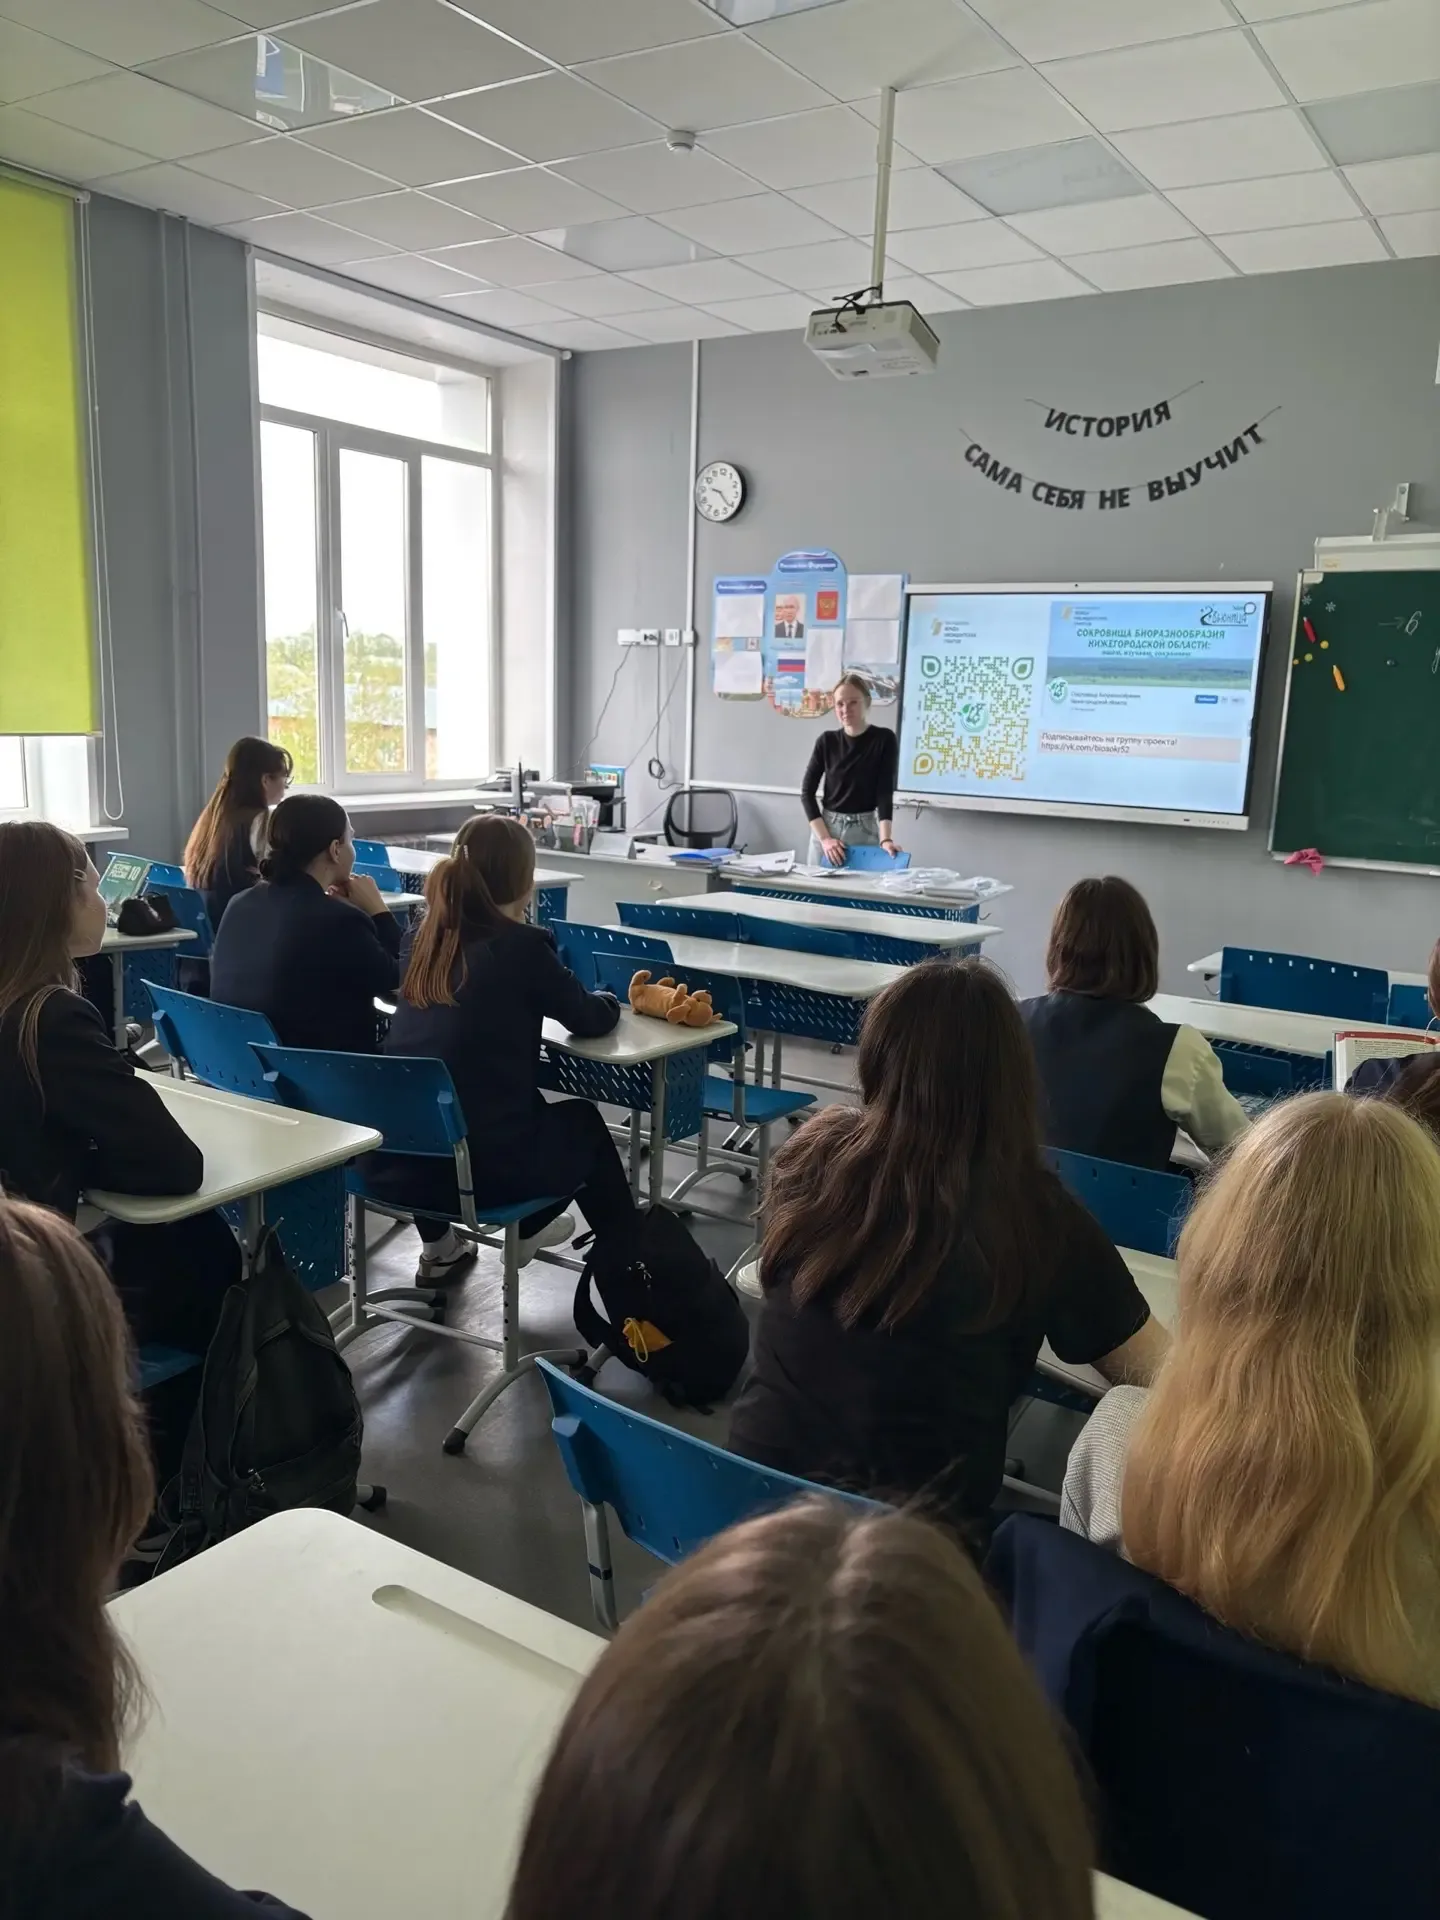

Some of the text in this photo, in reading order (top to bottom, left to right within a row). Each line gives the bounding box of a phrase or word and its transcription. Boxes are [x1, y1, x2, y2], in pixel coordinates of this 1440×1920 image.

[1044, 400, 1172, 438] ИСТОРИЯ
[964, 423, 1263, 510] САМА СЕБЯ НЕ ВЫУЧИТ
[1076, 629, 1225, 639] СОКРОВИЩА БИОРАЗНООБРАЗИЯ
[1088, 639, 1211, 650] НИЖЕГОРОДСКОЙ ОБЛАСТИ:
[1042, 732, 1105, 742] Подписывайтесь
[1116, 736, 1142, 745] группу
[1143, 737, 1178, 746] проекта!
[127, 865, 142, 881] 10
